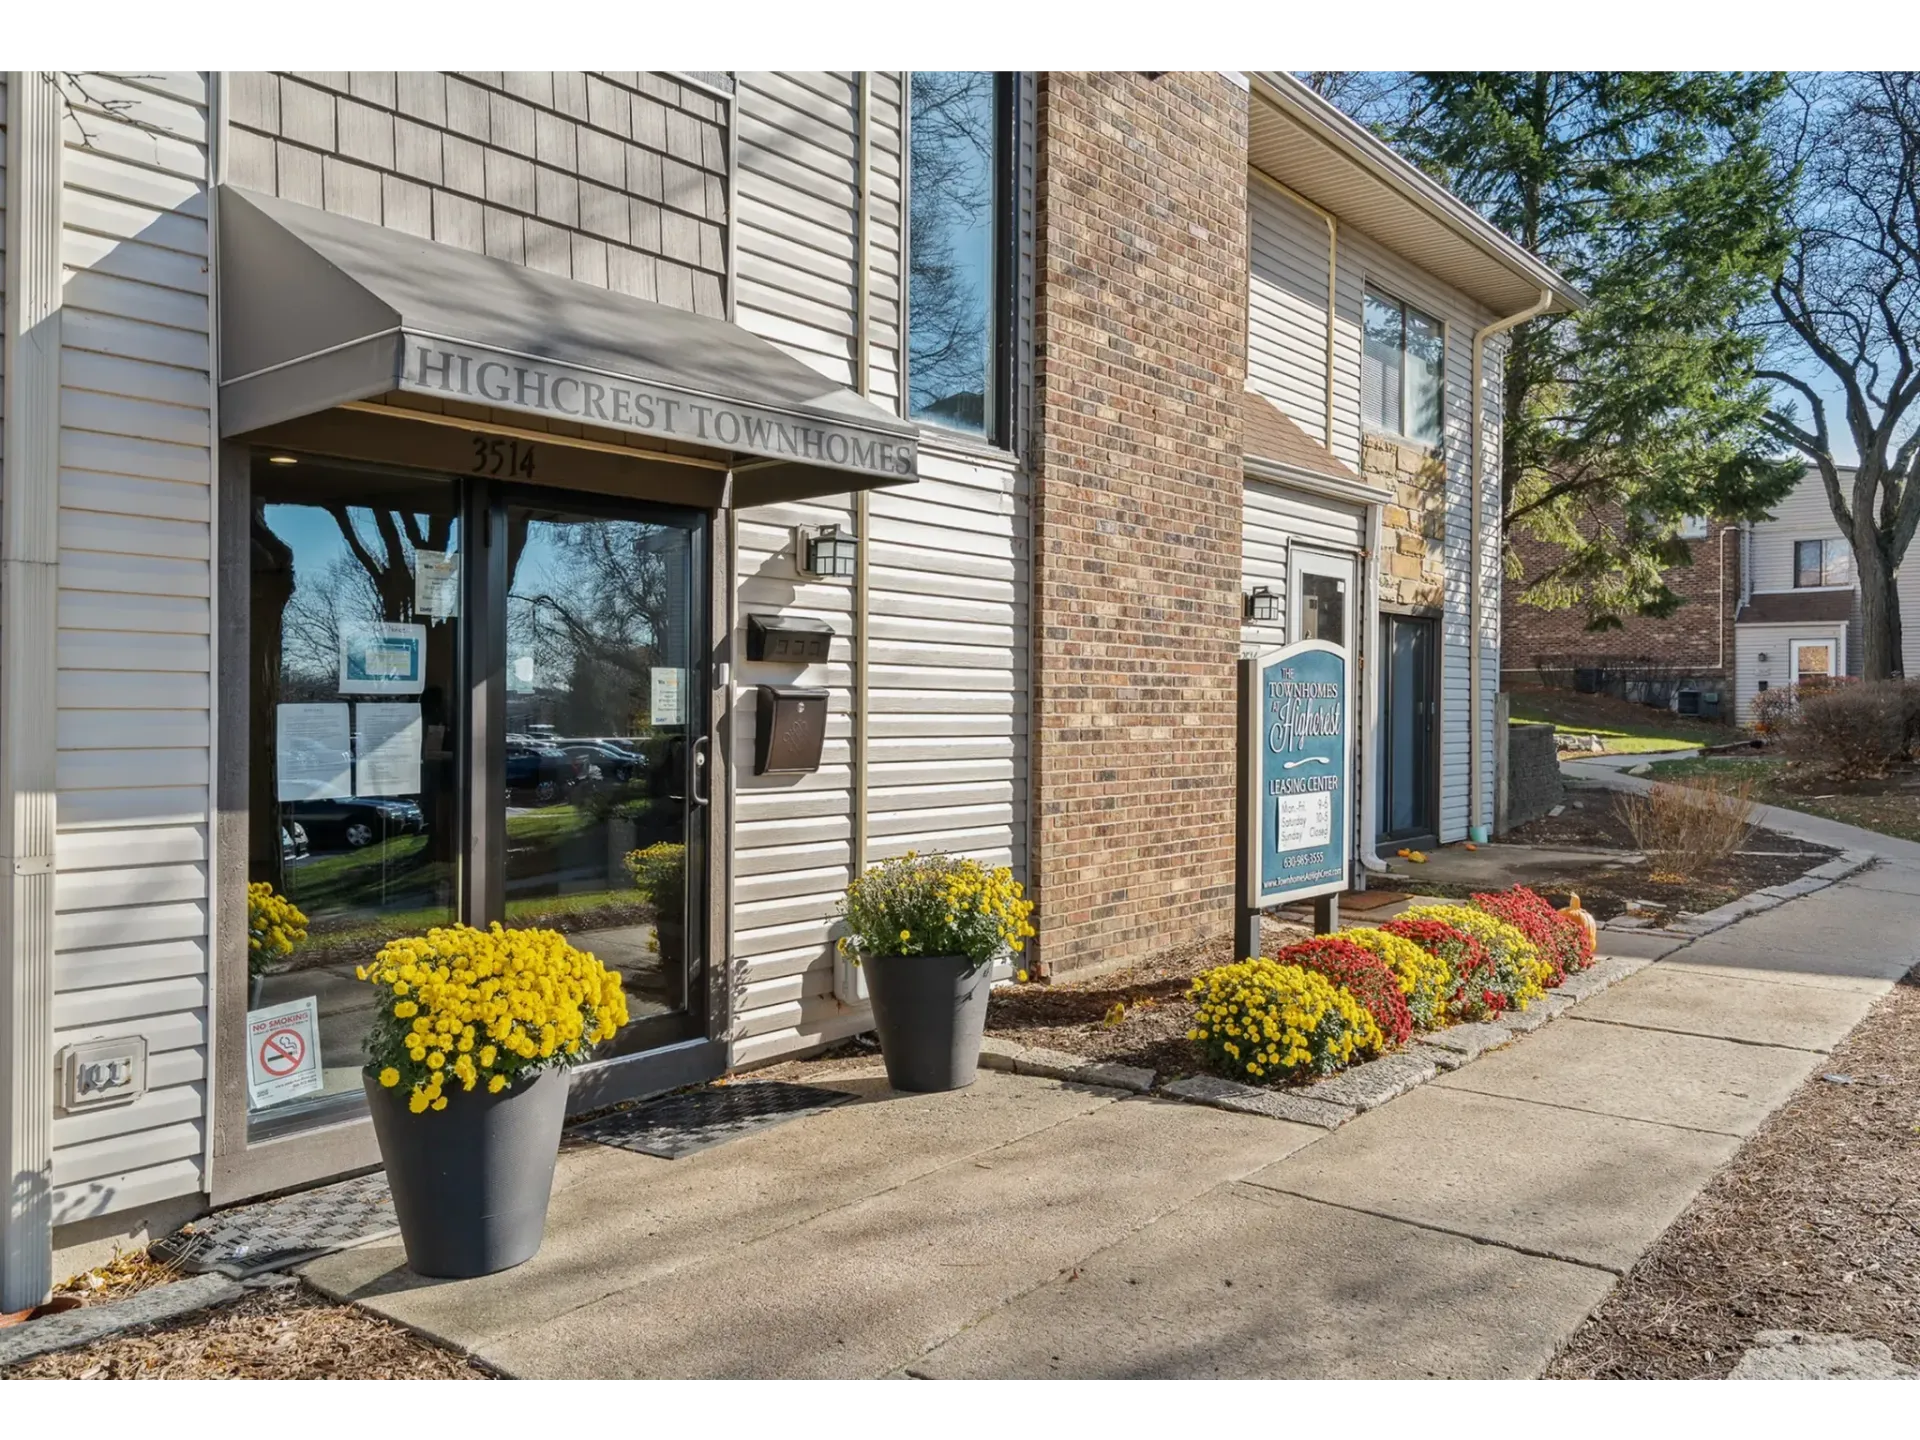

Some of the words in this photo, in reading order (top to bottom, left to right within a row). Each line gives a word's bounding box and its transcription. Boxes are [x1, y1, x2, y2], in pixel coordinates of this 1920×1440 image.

[414, 345, 682, 435] HIGHCREST
[689, 403, 912, 475] TOWNHOMES
[472, 437, 536, 478] 3514
[1281, 667, 1296, 680] THE
[1268, 682, 1339, 699] TOWNHOMES
[1268, 697, 1342, 753] Highcrest
[1269, 777, 1307, 796] LEASING
[1307, 775, 1339, 792] CENTER
[1281, 815, 1307, 829] Saturday
[1281, 829, 1303, 843] Sunday
[252, 1022, 267, 1032] NO
[268, 1012, 309, 1028] SMOKING
